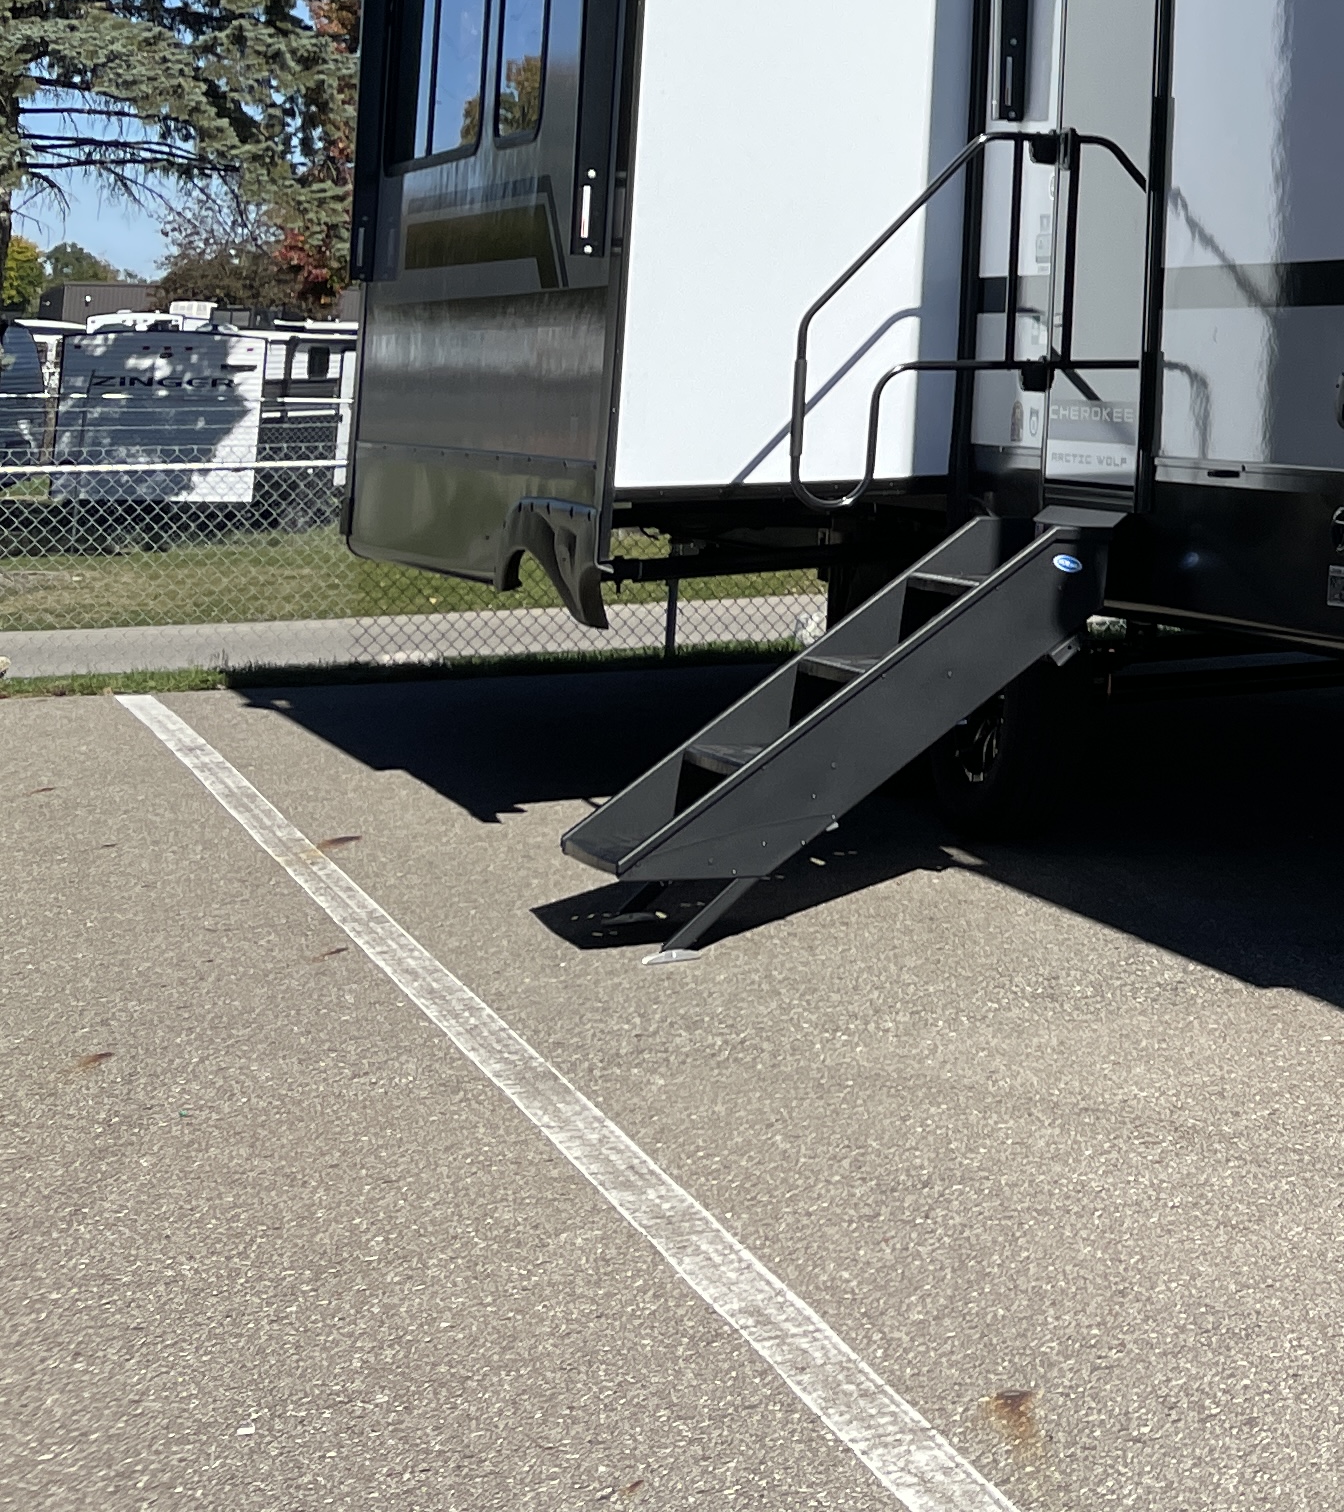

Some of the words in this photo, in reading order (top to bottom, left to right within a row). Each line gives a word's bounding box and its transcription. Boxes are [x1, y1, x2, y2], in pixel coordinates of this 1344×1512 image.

[92, 375, 234, 389] ZINGER
[1049, 405, 1134, 422] CHEROKEE
[1051, 452, 1092, 465] ARCTIC
[1096, 455, 1127, 467] WOLF
